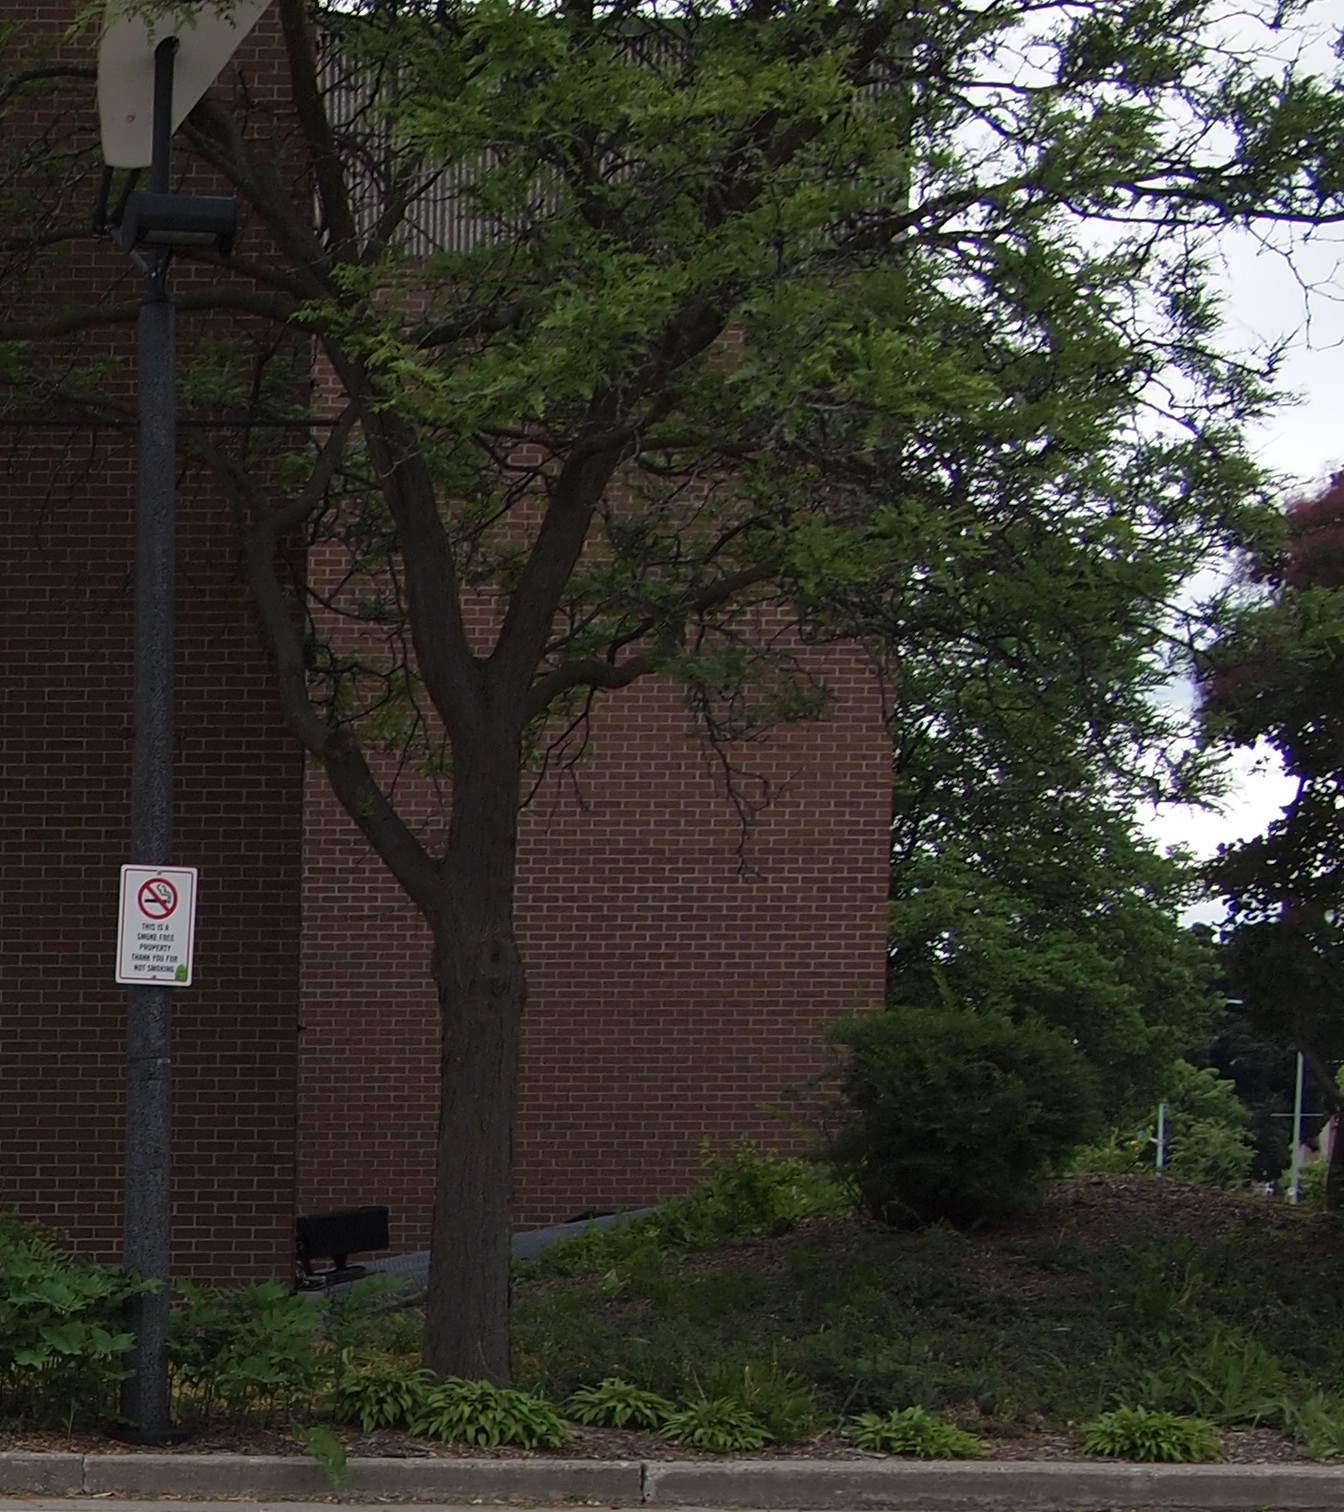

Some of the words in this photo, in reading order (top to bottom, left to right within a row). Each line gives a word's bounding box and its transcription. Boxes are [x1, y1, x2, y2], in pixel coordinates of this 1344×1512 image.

[142, 923, 155, 931] THIS
[157, 923, 164, 931] IS
[137, 933, 157, 941] SMOKE
[159, 934, 175, 942] FREE
[139, 943, 171, 952] PROPERTY
[166, 955, 178, 963] FOR
[147, 965, 174, 973] SMOKING
